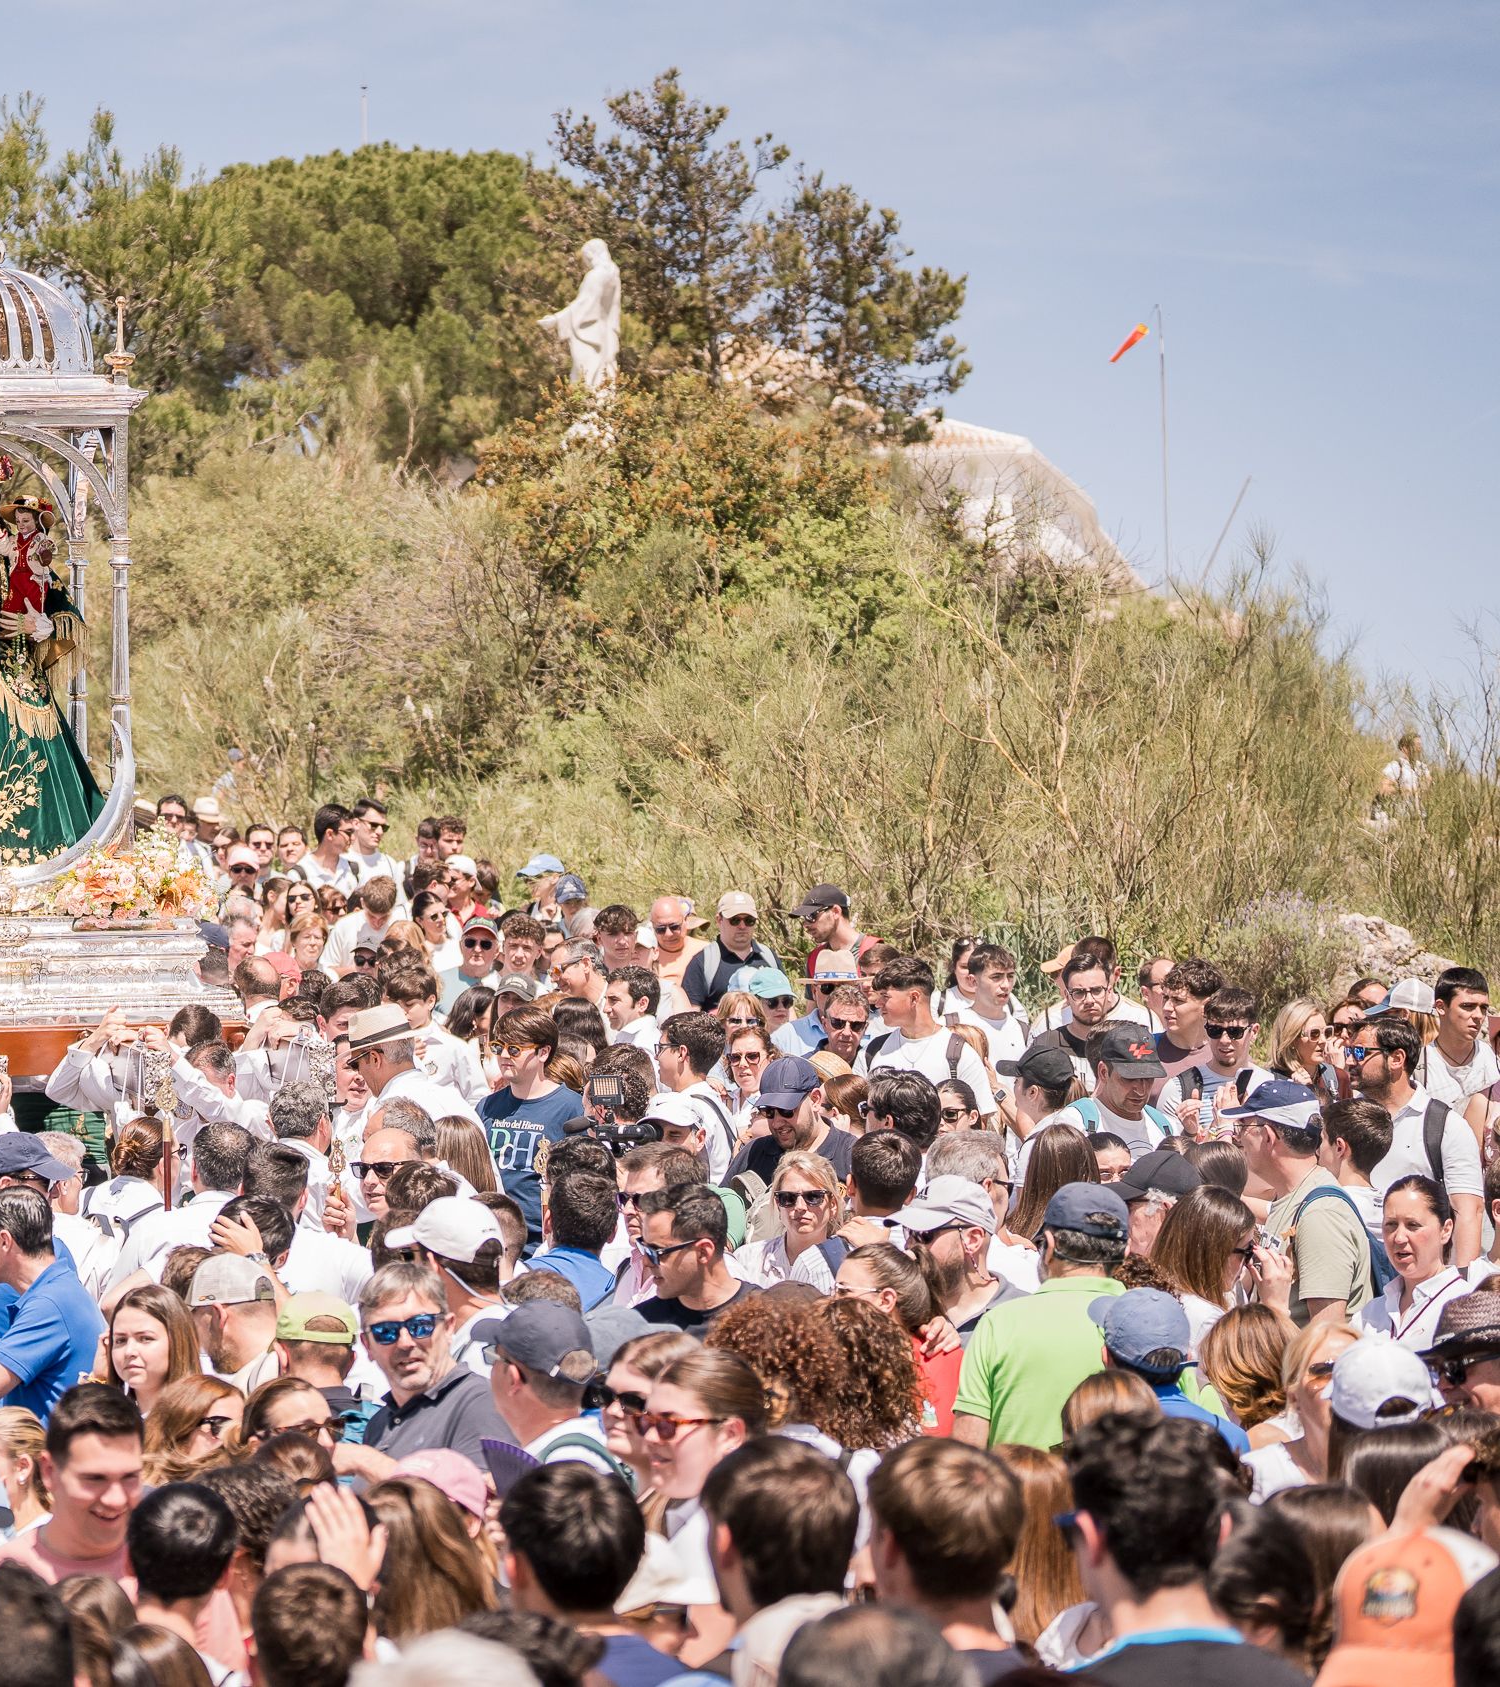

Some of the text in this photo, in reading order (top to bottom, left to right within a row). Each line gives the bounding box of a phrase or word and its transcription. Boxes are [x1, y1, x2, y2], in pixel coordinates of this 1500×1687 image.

[492, 1119, 545, 1131] Pedro del Hierro
